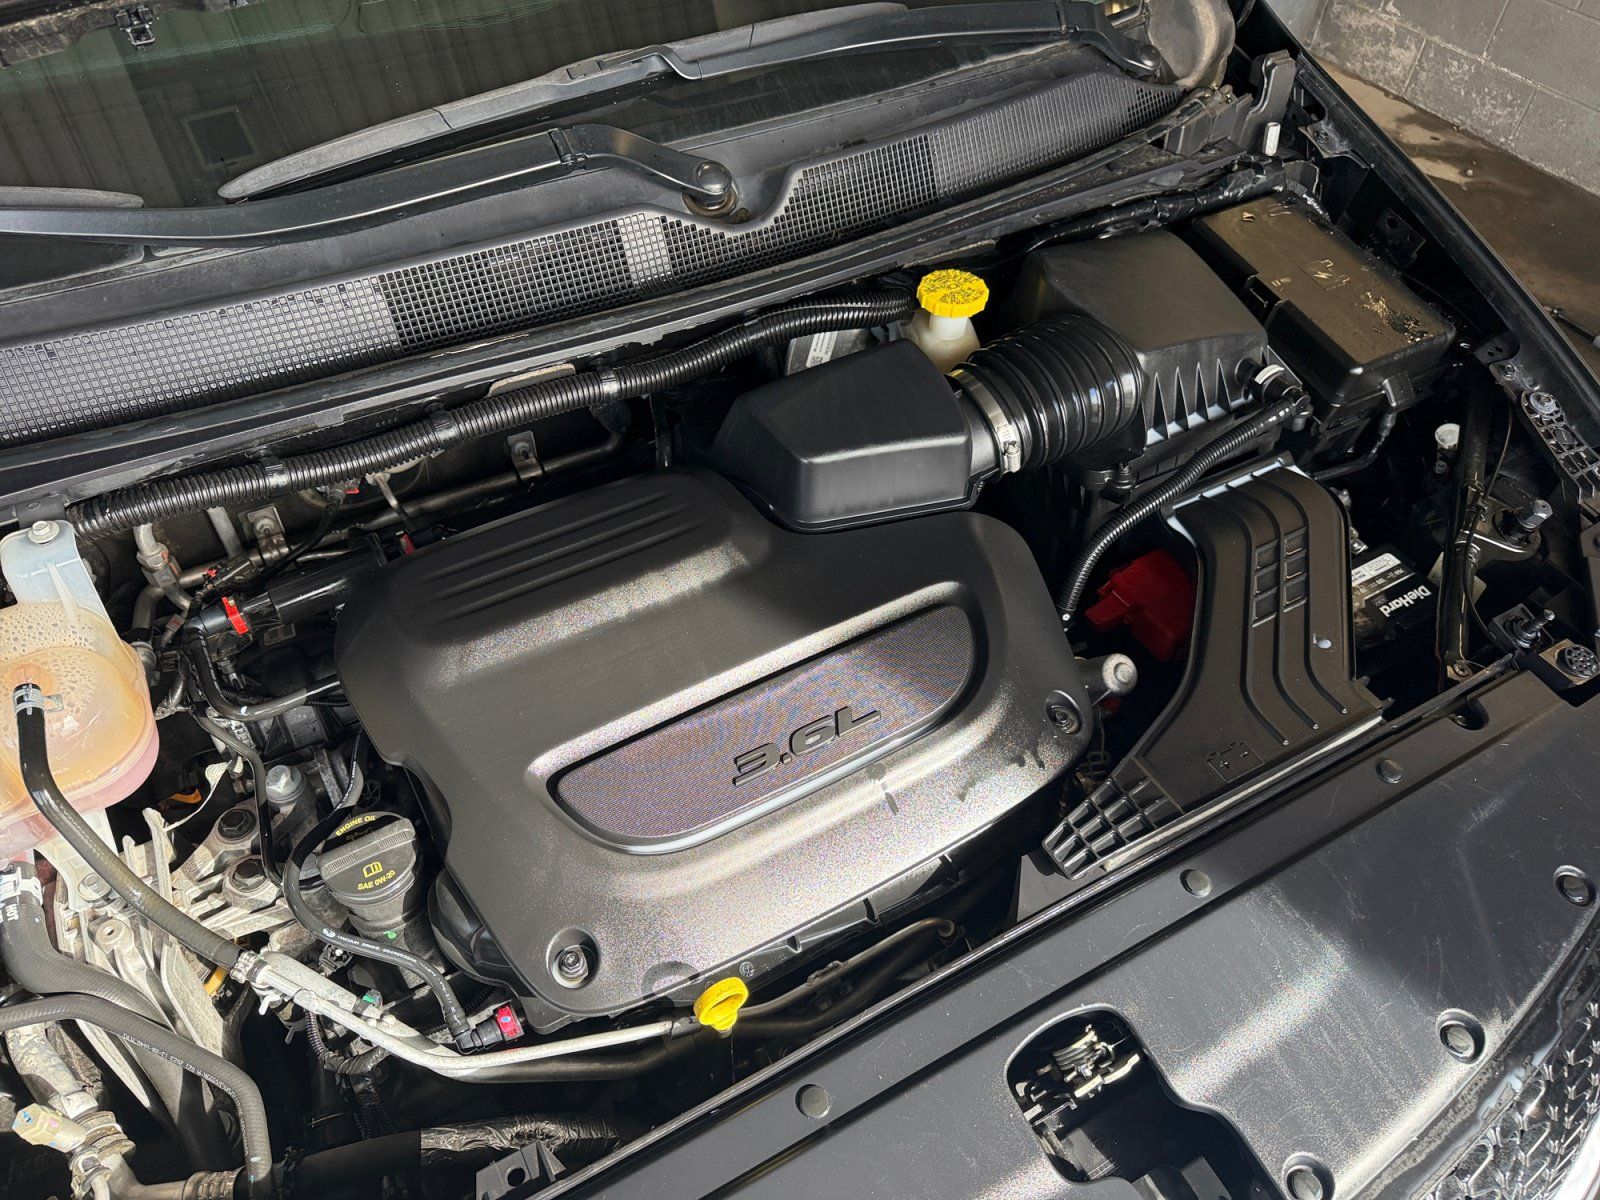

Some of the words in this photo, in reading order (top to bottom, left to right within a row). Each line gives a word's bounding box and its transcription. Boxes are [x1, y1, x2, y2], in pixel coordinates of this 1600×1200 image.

[1379, 584, 1432, 617] DieHard
[732, 705, 881, 787] 3.6L
[335, 817, 362, 836] ENGINE
[357, 880, 374, 890] SAE
[374, 870, 396, 886] 0W-20
[5, 903, 19, 921] HOT
